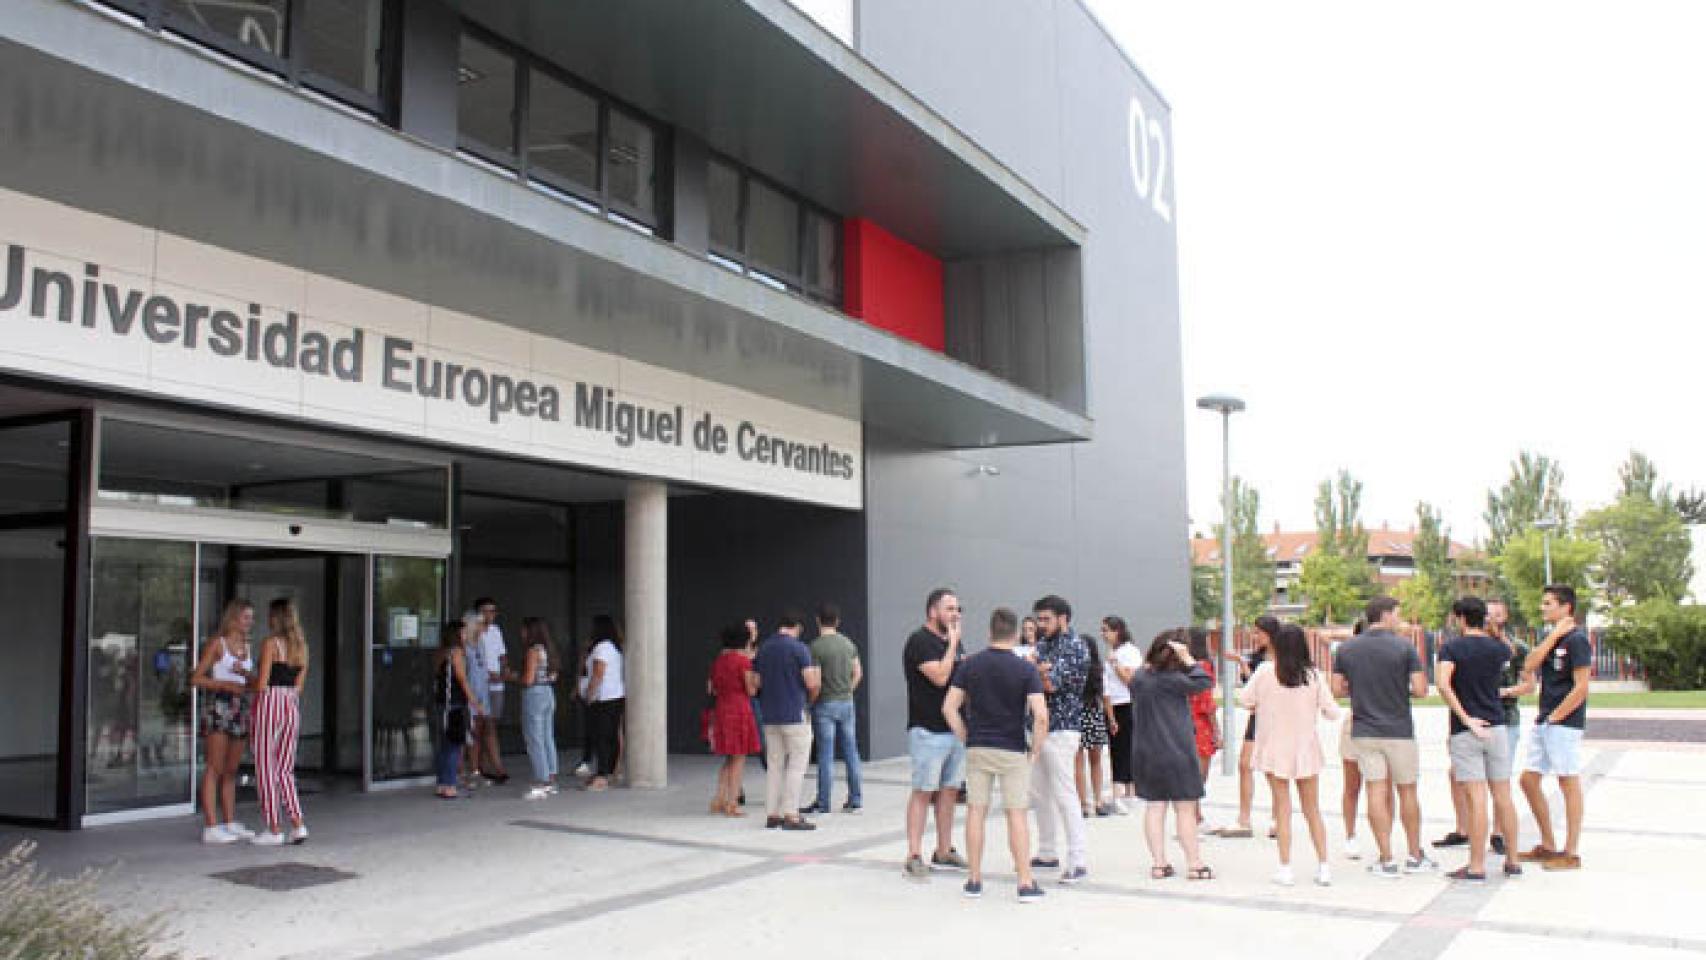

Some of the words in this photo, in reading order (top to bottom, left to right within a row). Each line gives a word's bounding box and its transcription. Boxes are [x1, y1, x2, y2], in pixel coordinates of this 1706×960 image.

[1129, 95, 1171, 223] 02
[381, 335, 560, 423] Europea
[574, 381, 684, 447] Miguel
[693, 413, 729, 455] de
[736, 420, 855, 481] Cervantes
